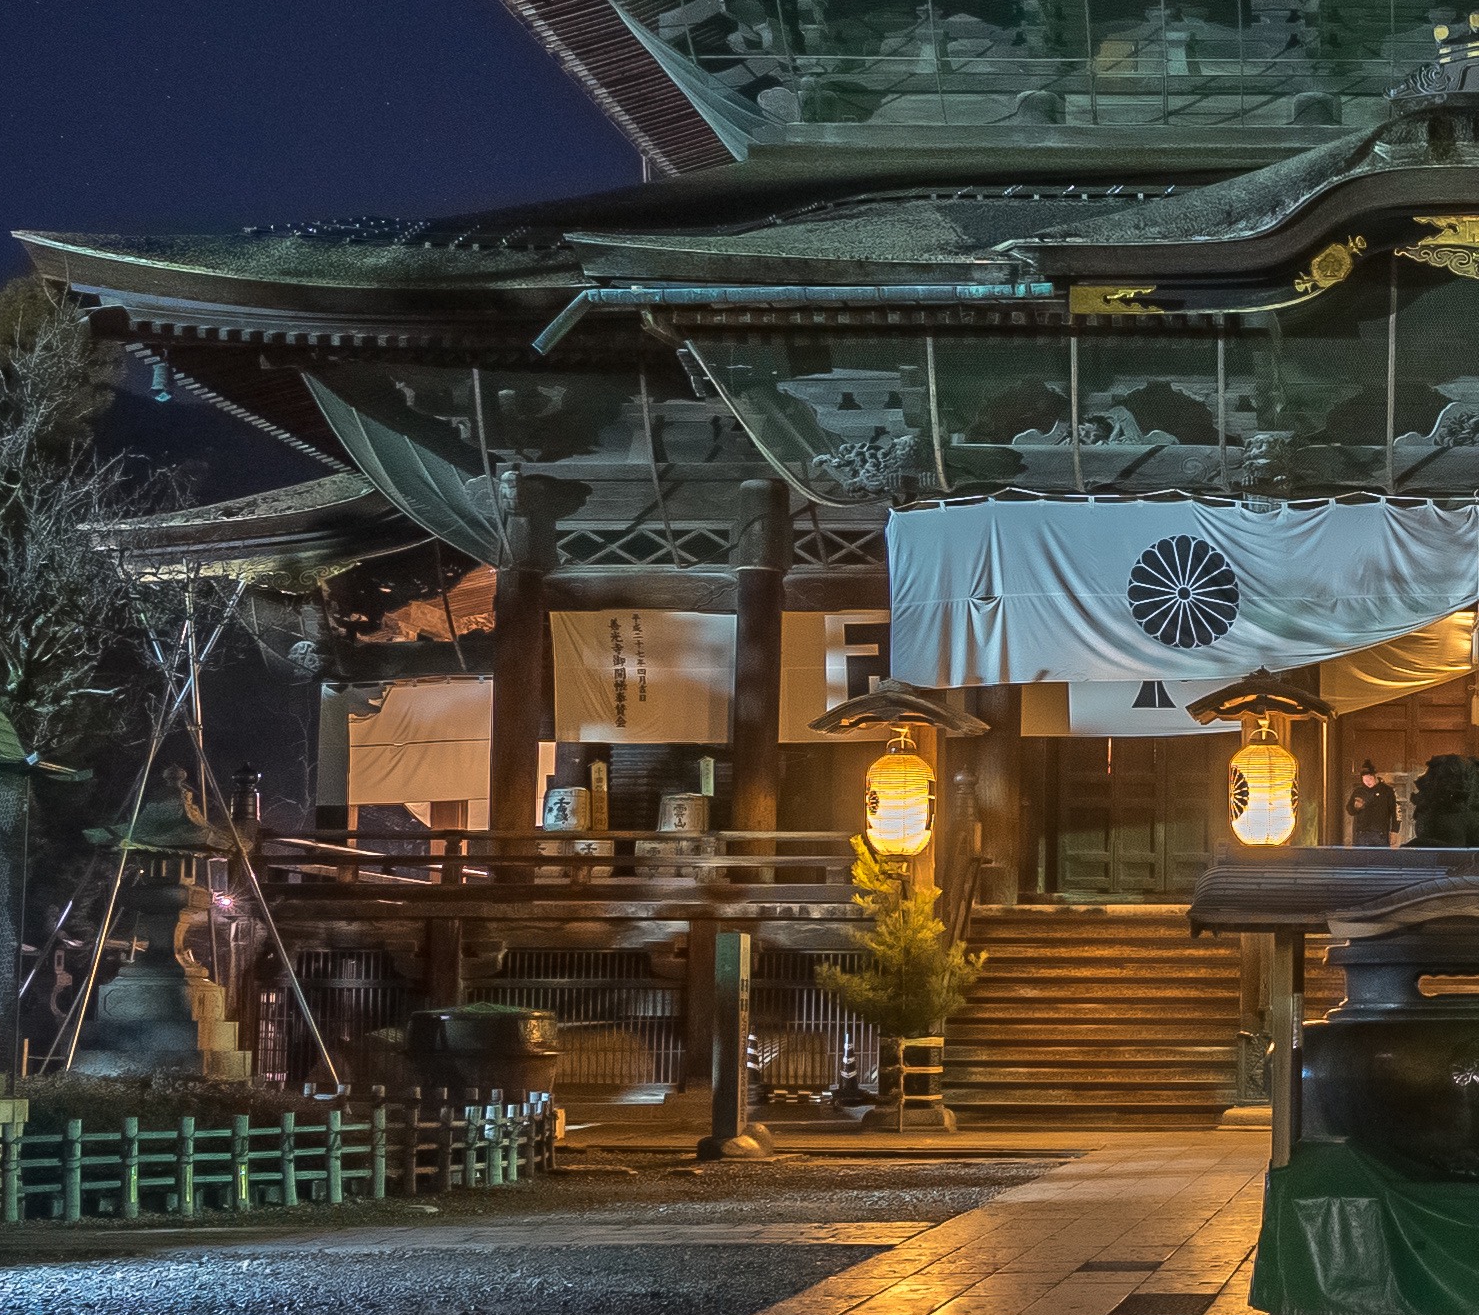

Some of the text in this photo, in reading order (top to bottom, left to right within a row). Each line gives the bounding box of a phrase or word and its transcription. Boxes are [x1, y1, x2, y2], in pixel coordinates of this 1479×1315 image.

[608, 617, 627, 728] 善光寺御開帳奉賛会
[631, 613, 647, 702] 平成二十七年四月吉日
